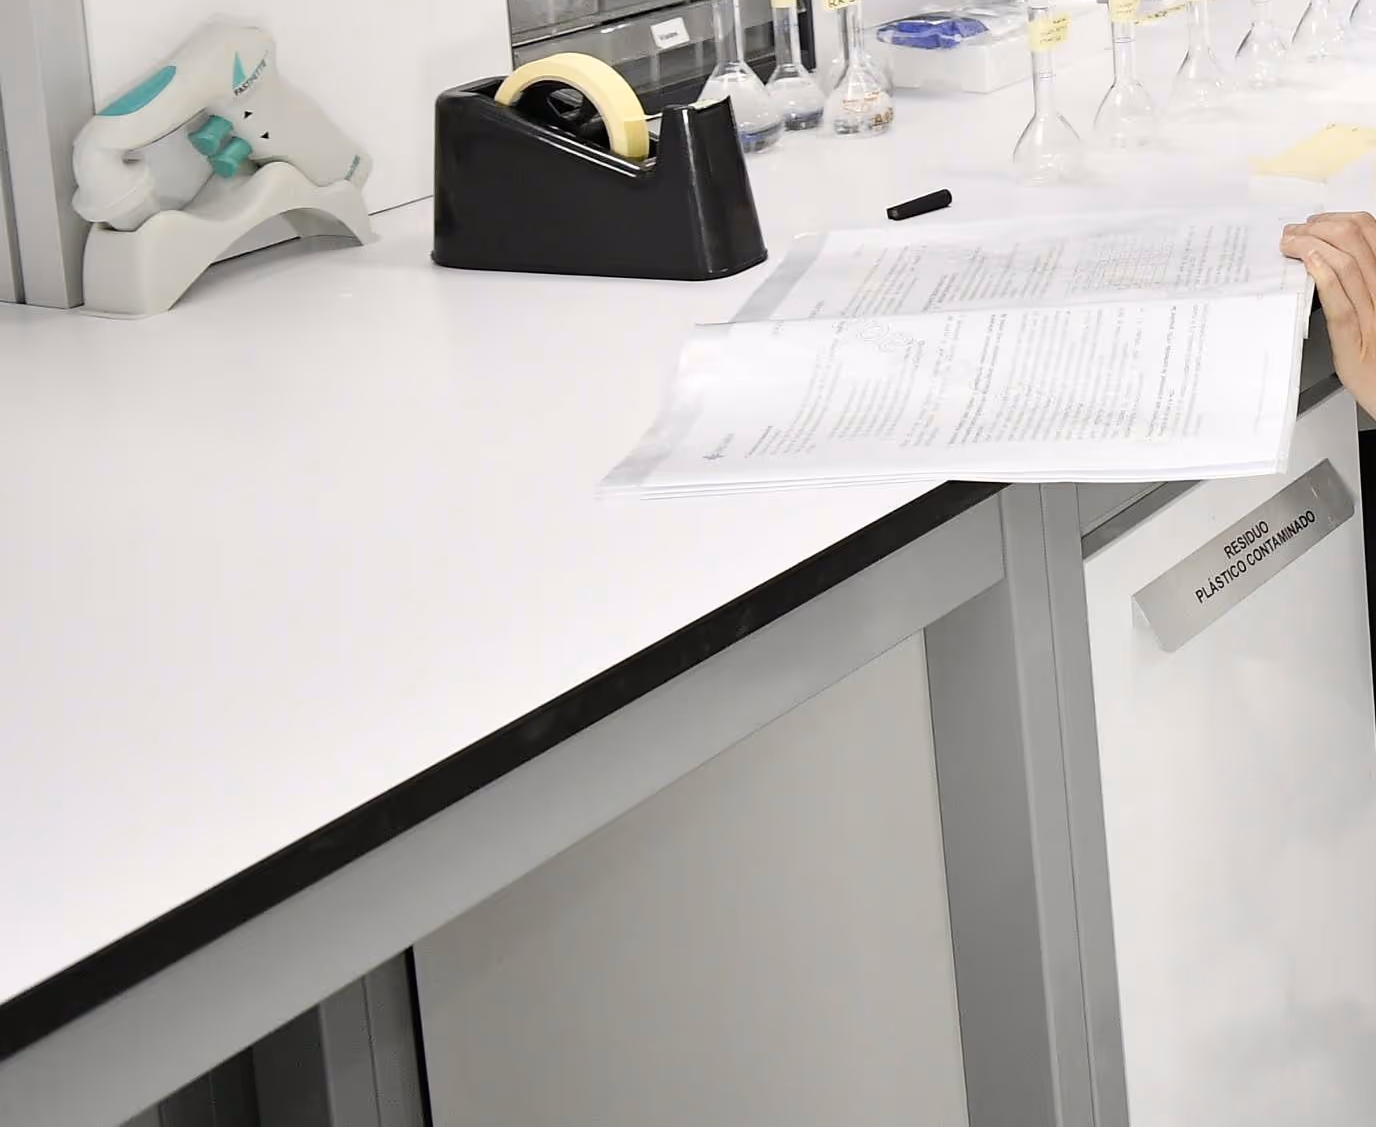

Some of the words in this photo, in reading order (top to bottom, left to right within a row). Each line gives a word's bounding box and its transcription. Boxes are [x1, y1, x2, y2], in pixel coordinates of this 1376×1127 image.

[1195, 560, 1247, 604] PLÁSTICO
[1246, 510, 1316, 566] CONTAMINADO
[1223, 520, 1270, 559] RESIDUO
